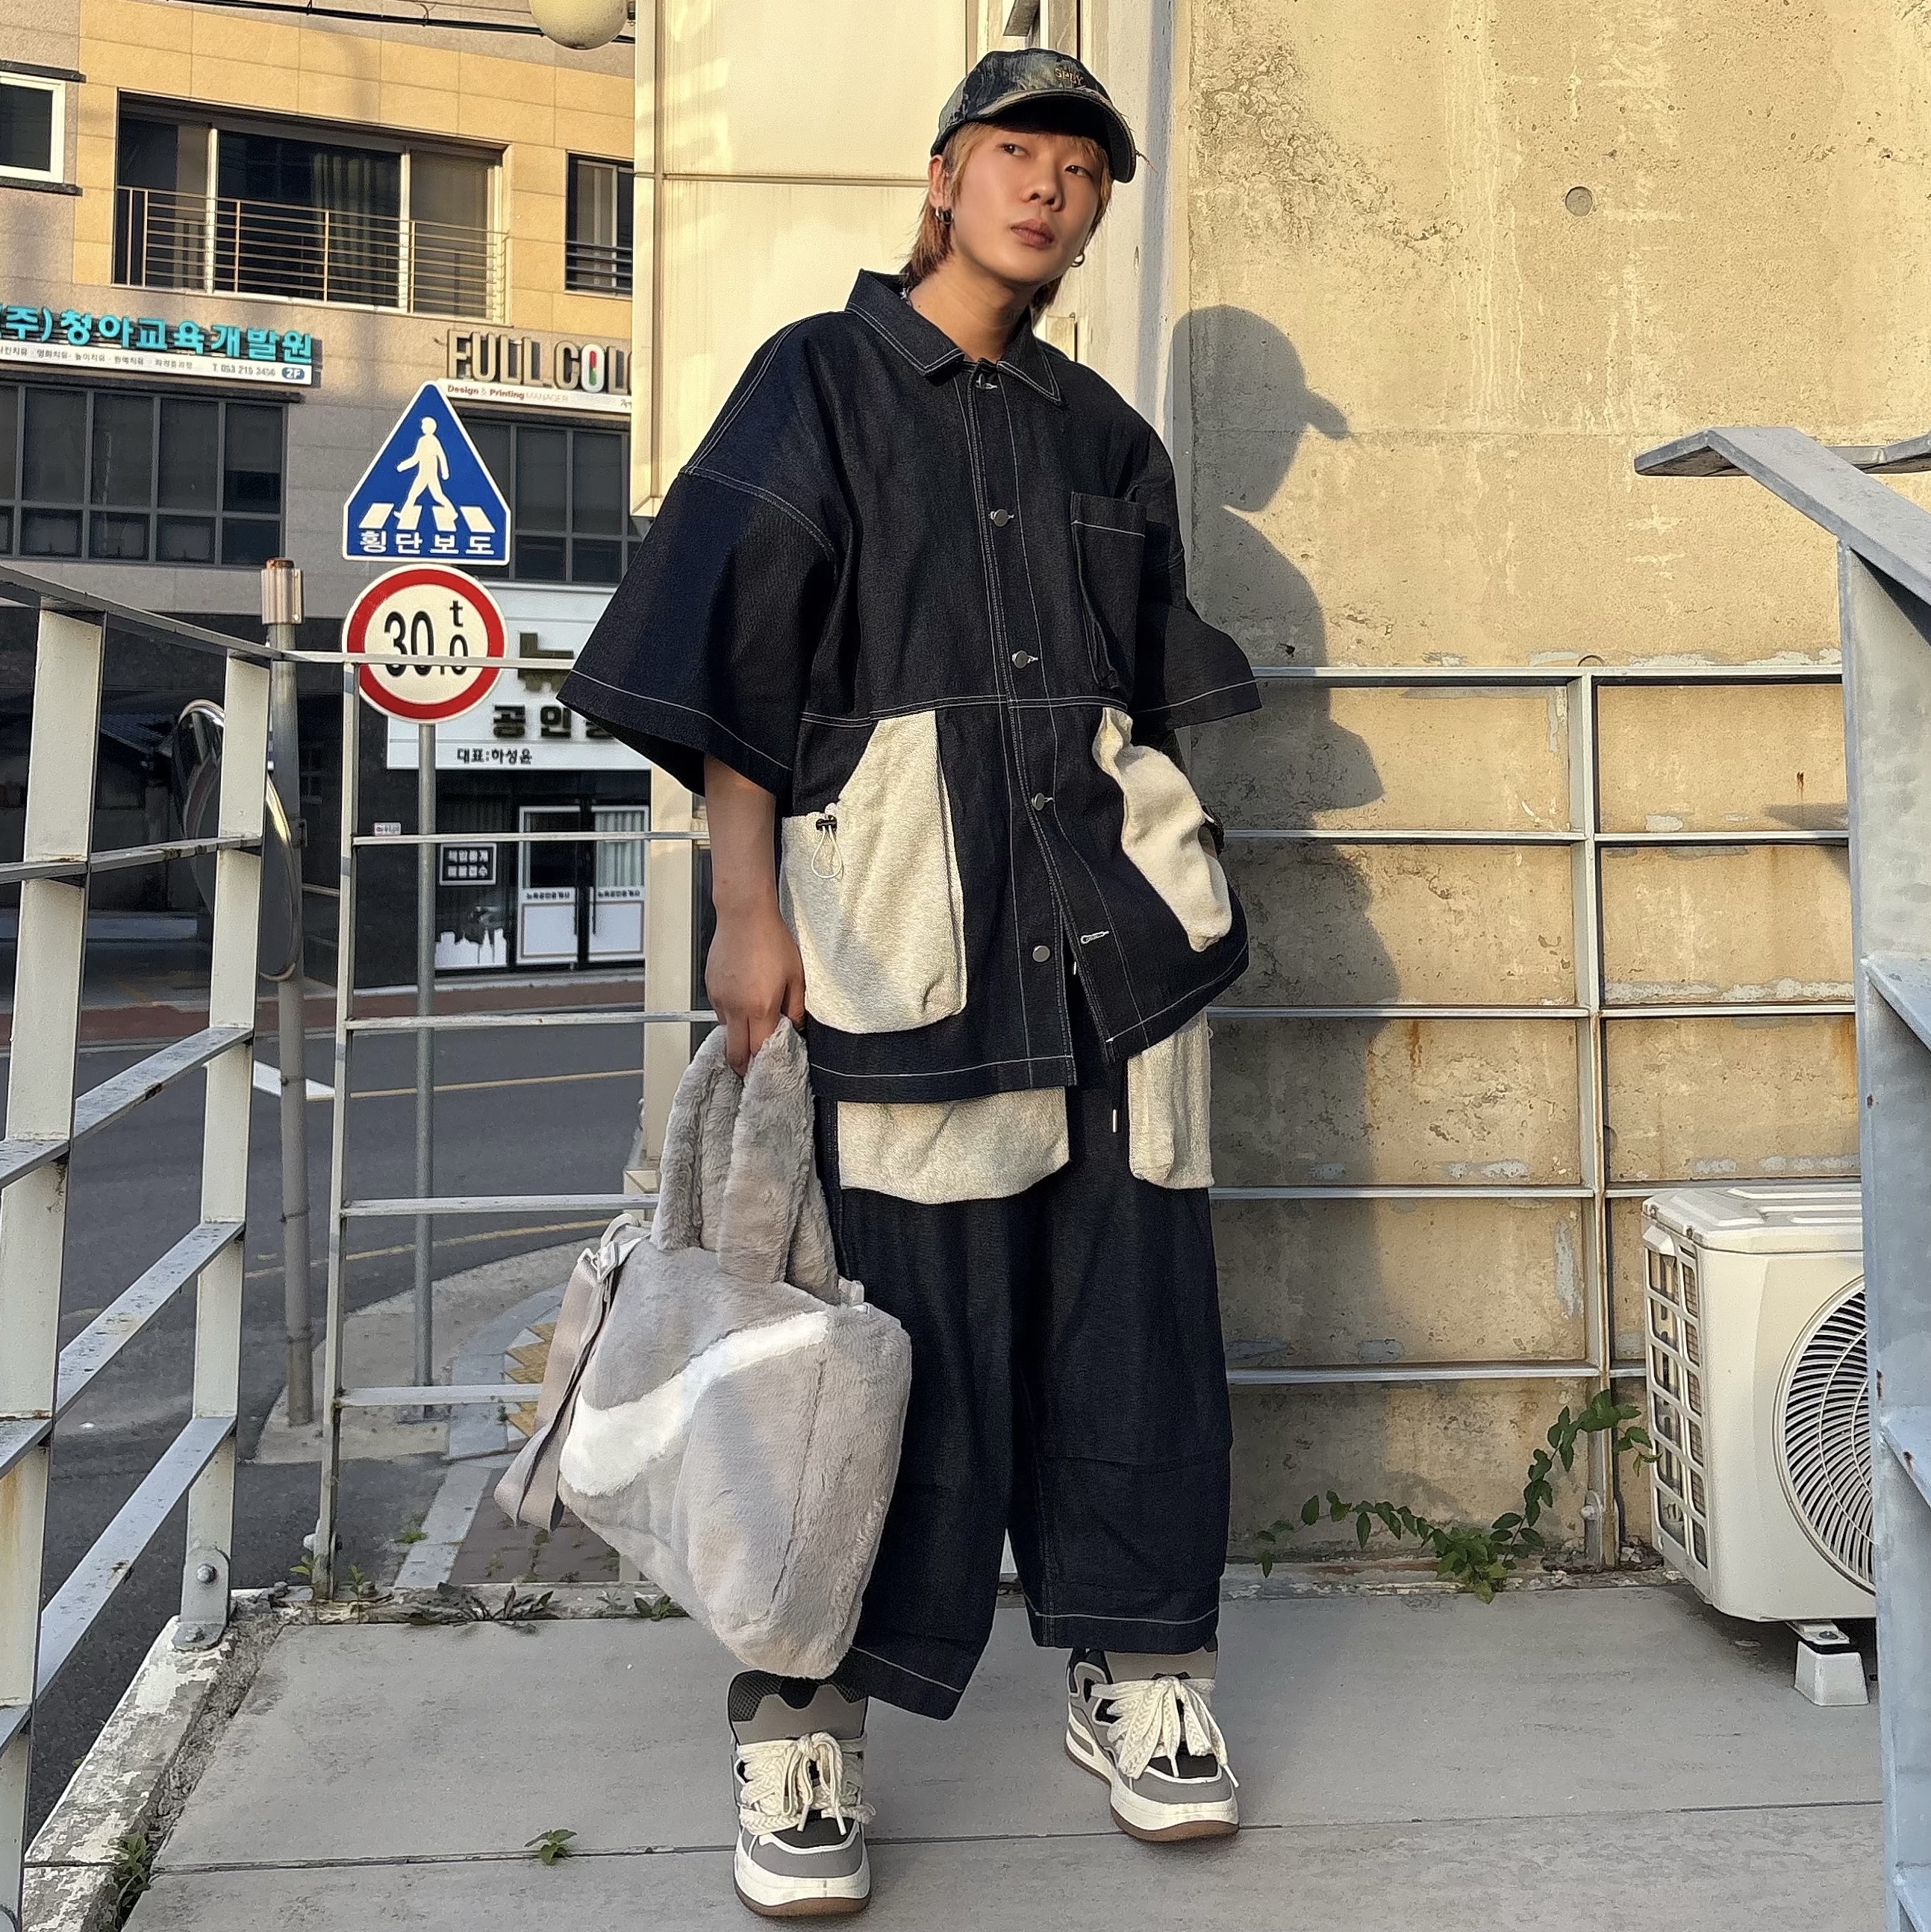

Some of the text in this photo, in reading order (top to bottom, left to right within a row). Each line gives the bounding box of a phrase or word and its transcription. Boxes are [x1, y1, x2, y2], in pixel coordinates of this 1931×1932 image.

[286, 369, 301, 379] 2F
[447, 329, 631, 395] FULL COL
[447, 384, 478, 396] Design
[489, 387, 524, 401] Printing
[358, 530, 496, 556] 횡단보도
[449, 600, 464, 627] t
